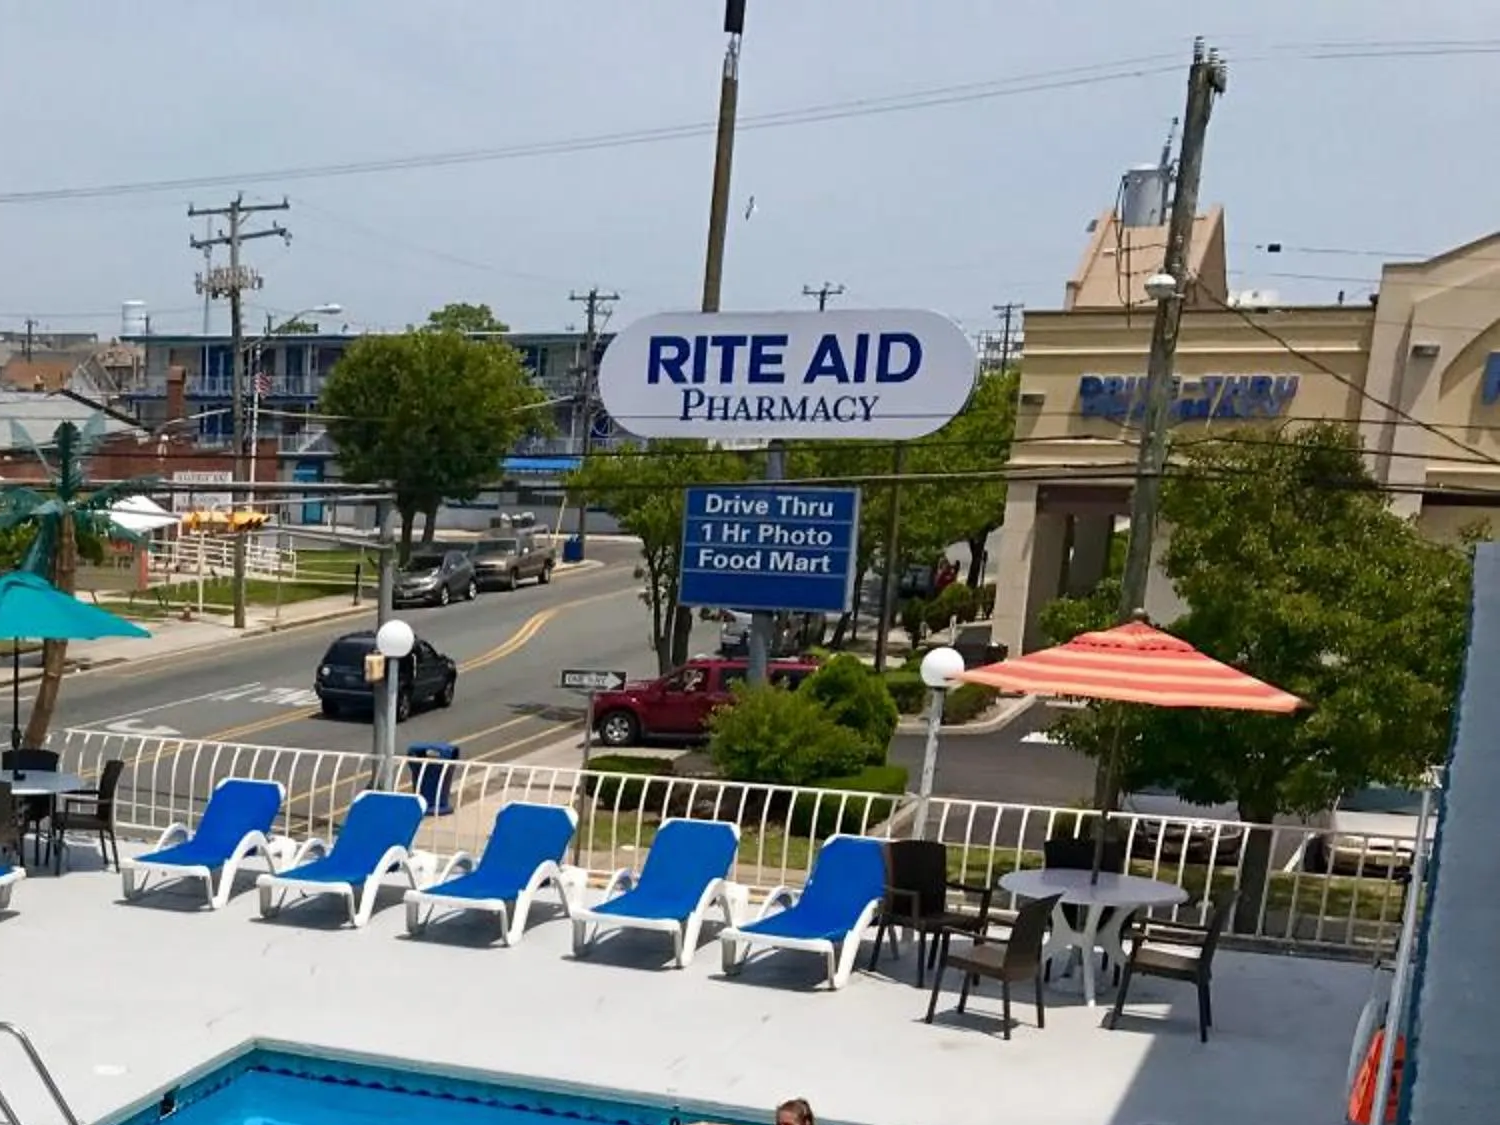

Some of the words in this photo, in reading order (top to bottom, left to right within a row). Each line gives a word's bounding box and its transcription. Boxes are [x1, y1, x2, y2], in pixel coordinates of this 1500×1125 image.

[648, 333, 788, 384] RITE
[803, 331, 923, 384] AID
[679, 388, 880, 422] PHARMACY
[705, 493, 769, 515] Drive
[777, 495, 834, 517] Thru
[701, 523, 713, 542] 1
[721, 523, 751, 543] Hr
[757, 524, 833, 546] Photo
[698, 549, 762, 569] Food
[769, 551, 832, 573] Mart
